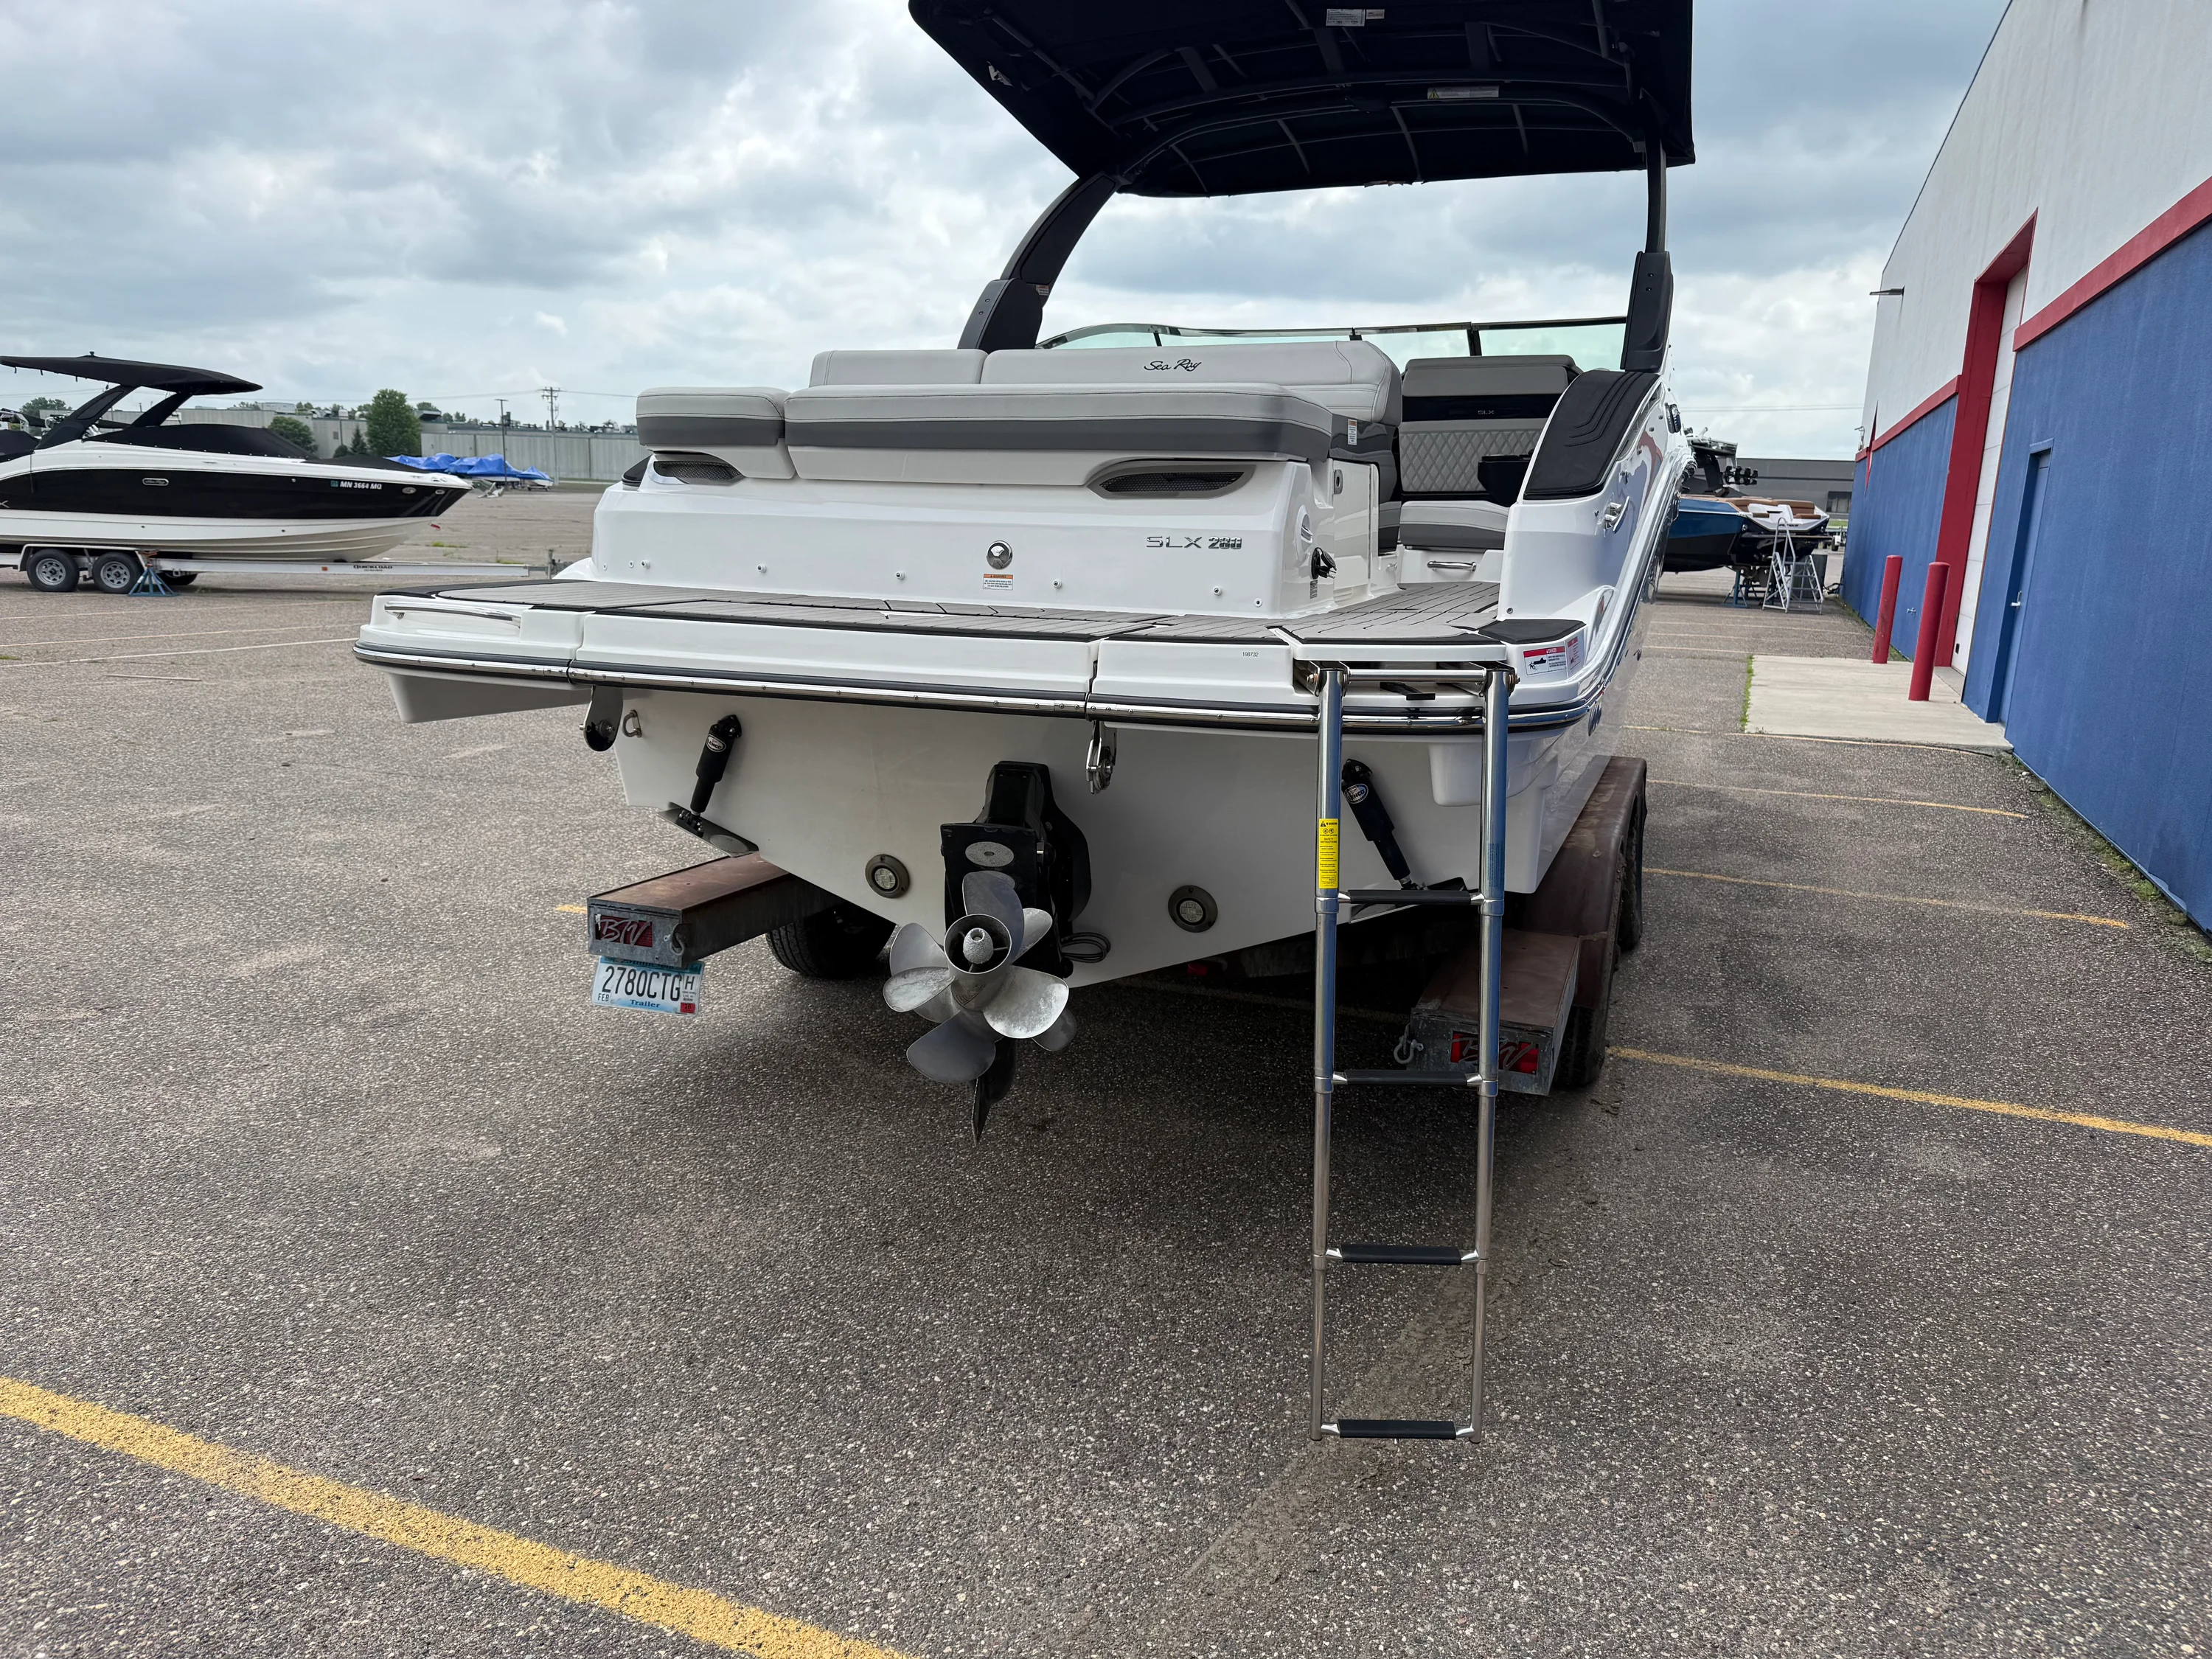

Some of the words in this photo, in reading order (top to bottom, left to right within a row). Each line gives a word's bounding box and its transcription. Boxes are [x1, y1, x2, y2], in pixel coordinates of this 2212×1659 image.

[1144, 361, 1172, 371] Sea
[1173, 358, 1202, 372] Ray
[1146, 536, 1202, 549] SLX
[1208, 536, 1242, 549] 280
[602, 966, 682, 1001] 2780CTG
[685, 975, 695, 990] H
[598, 992, 610, 1001] FEB
[630, 999, 661, 1009] Trailer
